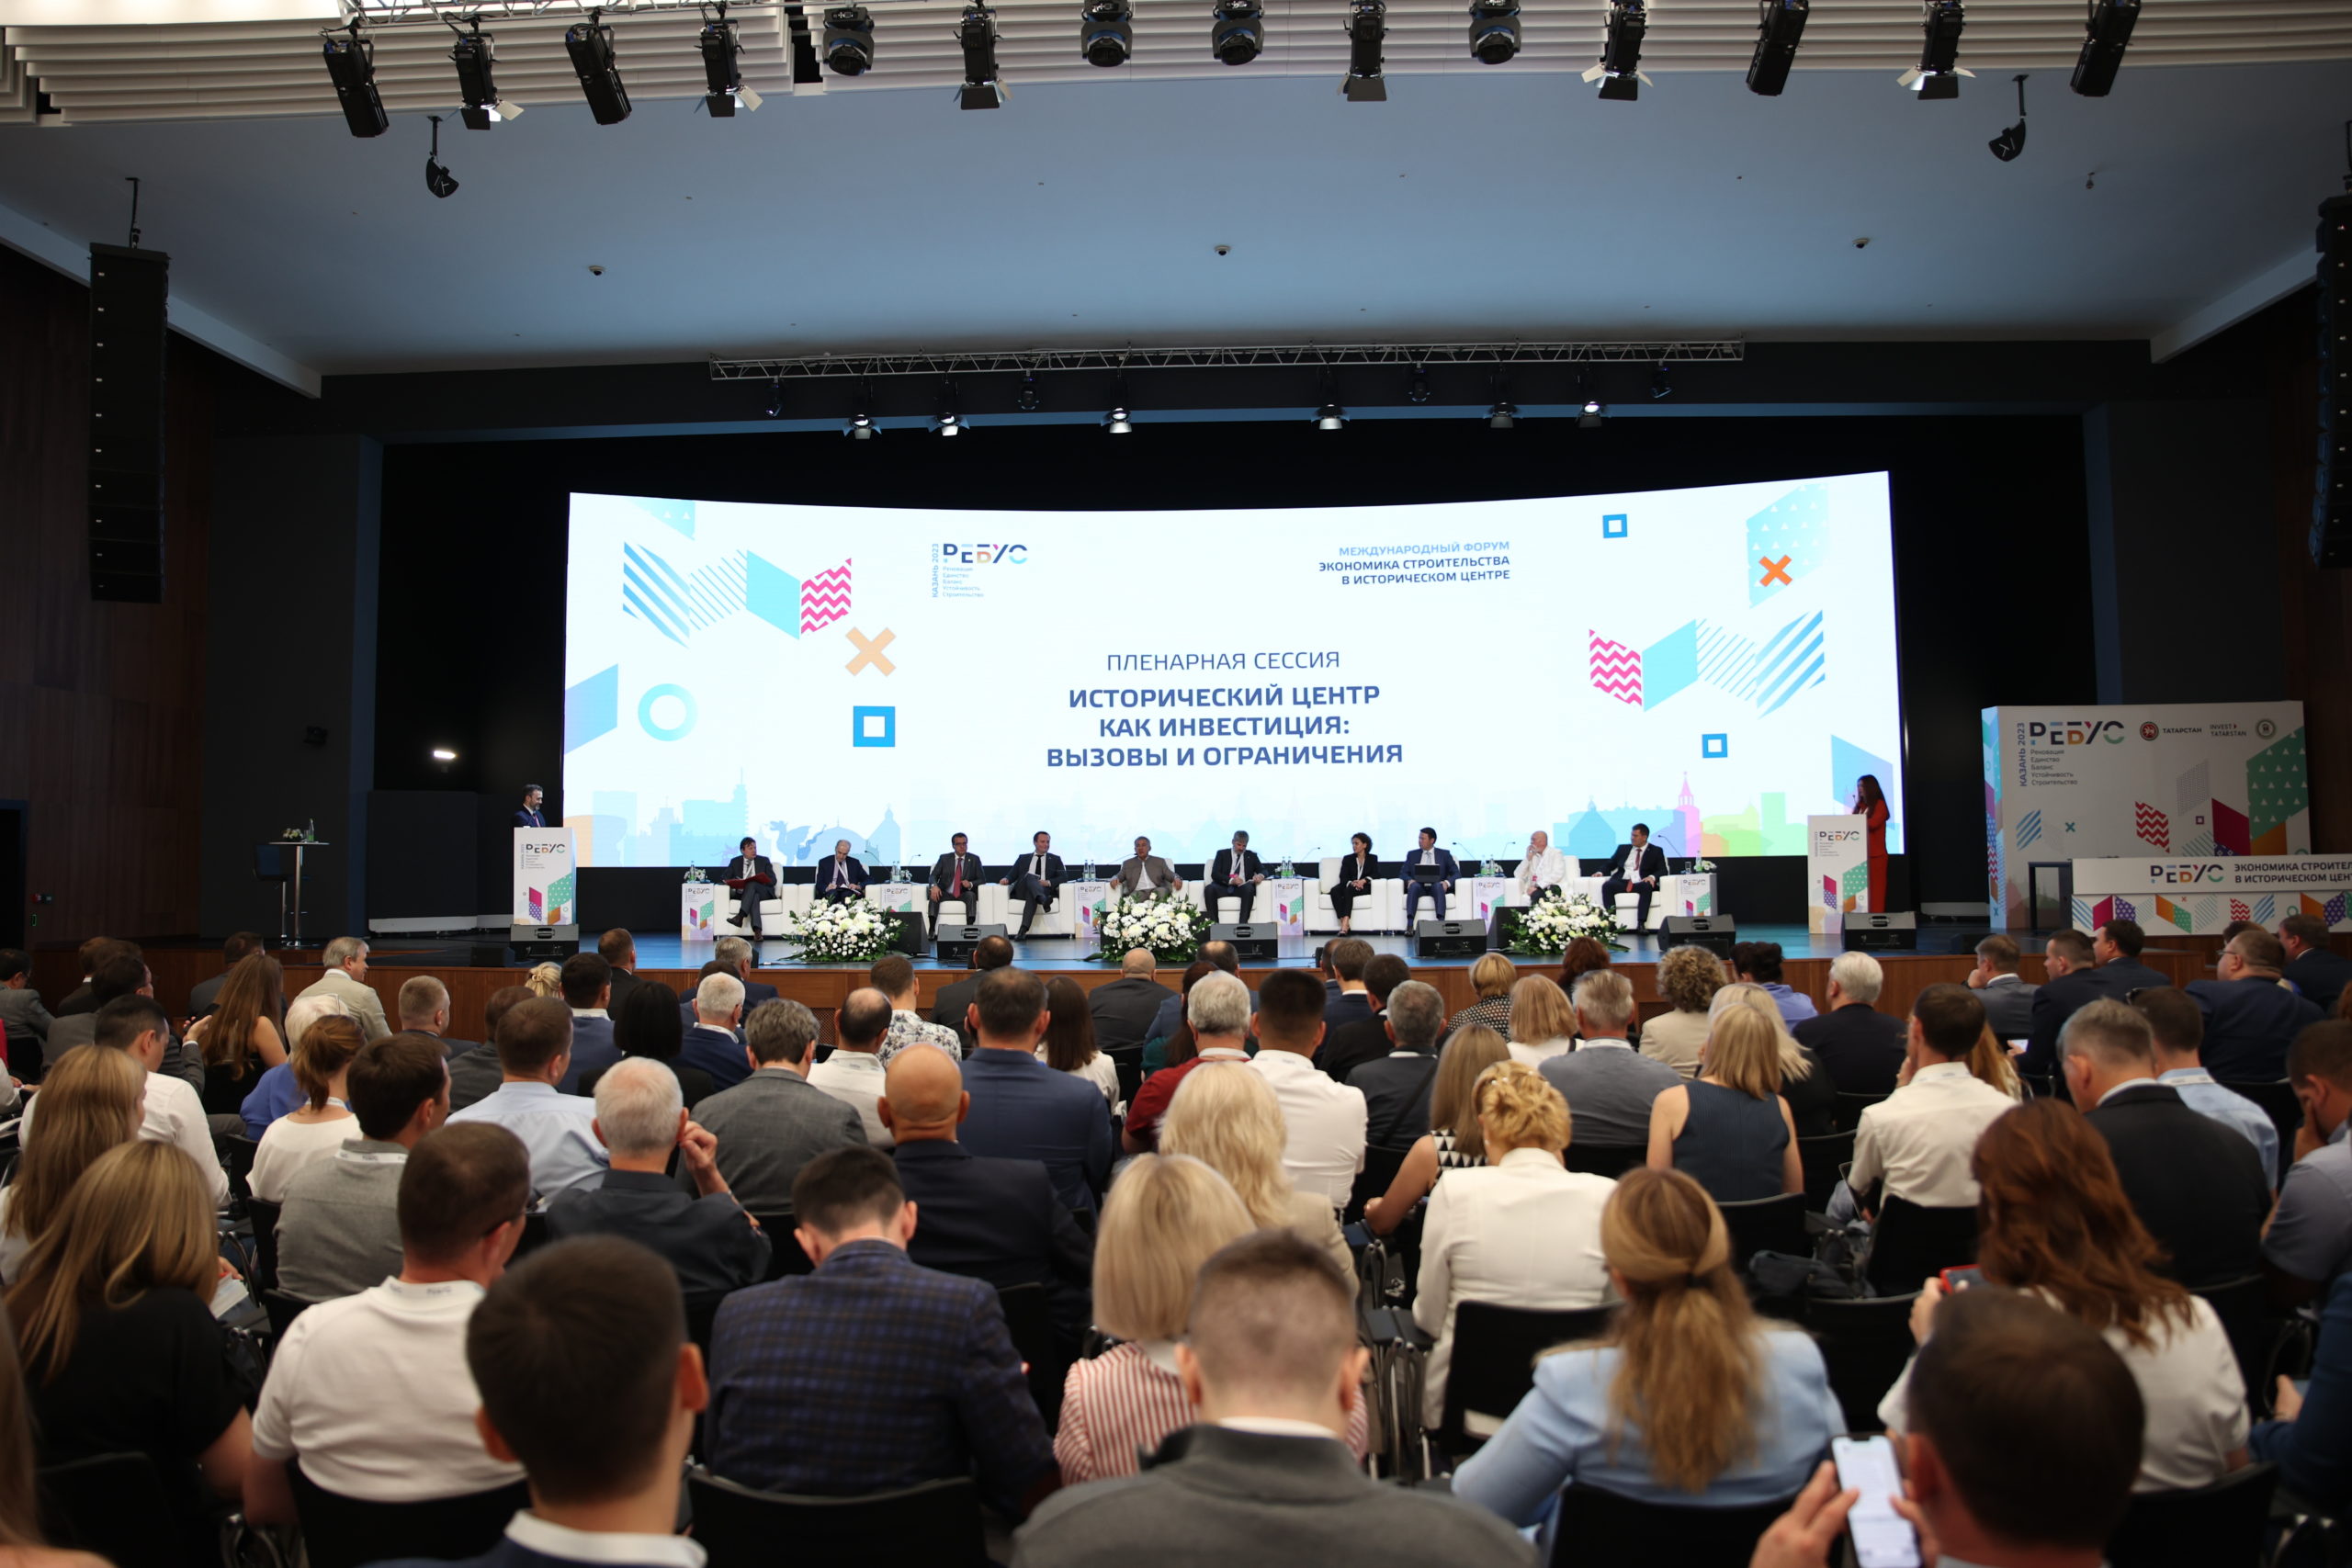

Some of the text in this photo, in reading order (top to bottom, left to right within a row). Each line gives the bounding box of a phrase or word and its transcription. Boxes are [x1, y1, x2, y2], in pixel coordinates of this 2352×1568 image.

[943, 544, 1028, 564] РЕБУС
[1340, 541, 1510, 556] МЕЖДУНАРОДНЫЙ ФОРУМ
[1319, 556, 1510, 571] ЭКОНОМИКА СТРОИТЕЛЬСТВА
[1341, 570, 1510, 585] В ИСТОРИЧЕСКОМ ЦЕНТРЕ
[1107, 651, 1340, 671] ПЛЕНАРНАЯ СЕССИЯ
[1069, 683, 1380, 708] ИСТОРИЧЕСКИЙ ЦЕНТР
[1100, 716, 1350, 738] КАК ИНВЕСТИЦИЯ:
[2030, 721, 2125, 745] РЕБУС
[1047, 745, 1403, 766] ВЫЗОВЫ И ОГРАНИЧЕНИЯ
[2017, 722, 2027, 787] КАЗАНЬ 2023
[2151, 864, 2223, 884] РЕБУС
[2234, 863, 2298, 872] ЭКОНОМИКА
[2245, 874, 2327, 883] ИСТОРИЧЕСКОМ
